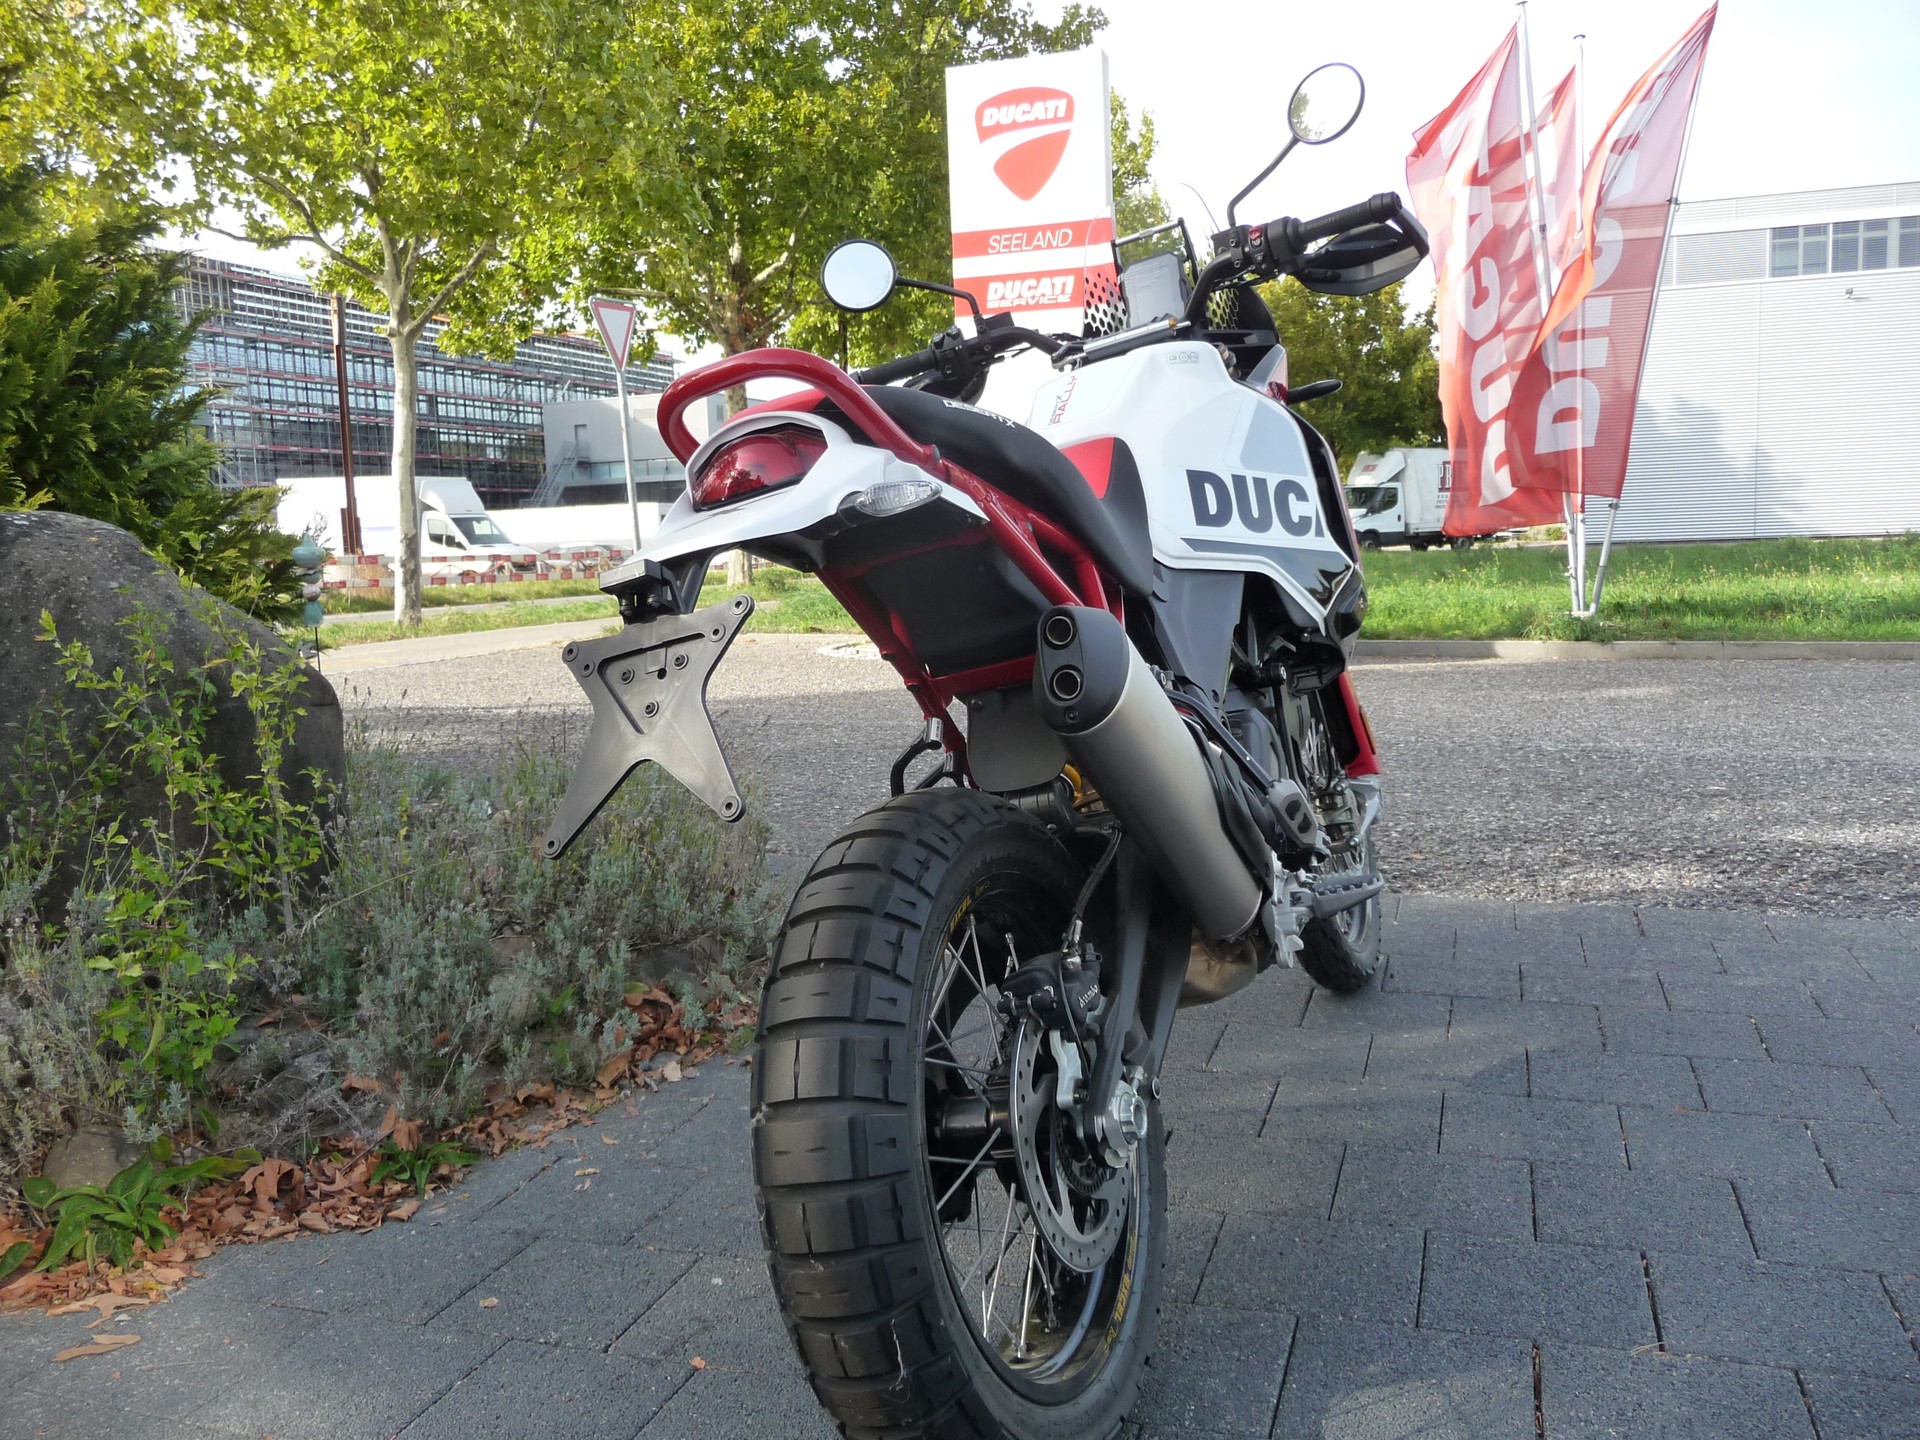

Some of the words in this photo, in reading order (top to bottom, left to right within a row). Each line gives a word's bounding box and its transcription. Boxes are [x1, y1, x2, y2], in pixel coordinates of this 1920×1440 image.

[981, 98, 1068, 127] DUCATI
[987, 228, 1073, 254] SEELAND
[987, 275, 1075, 301] DUCATI
[986, 294, 1073, 309] SERVICE
[1053, 375, 1078, 425] RALLY
